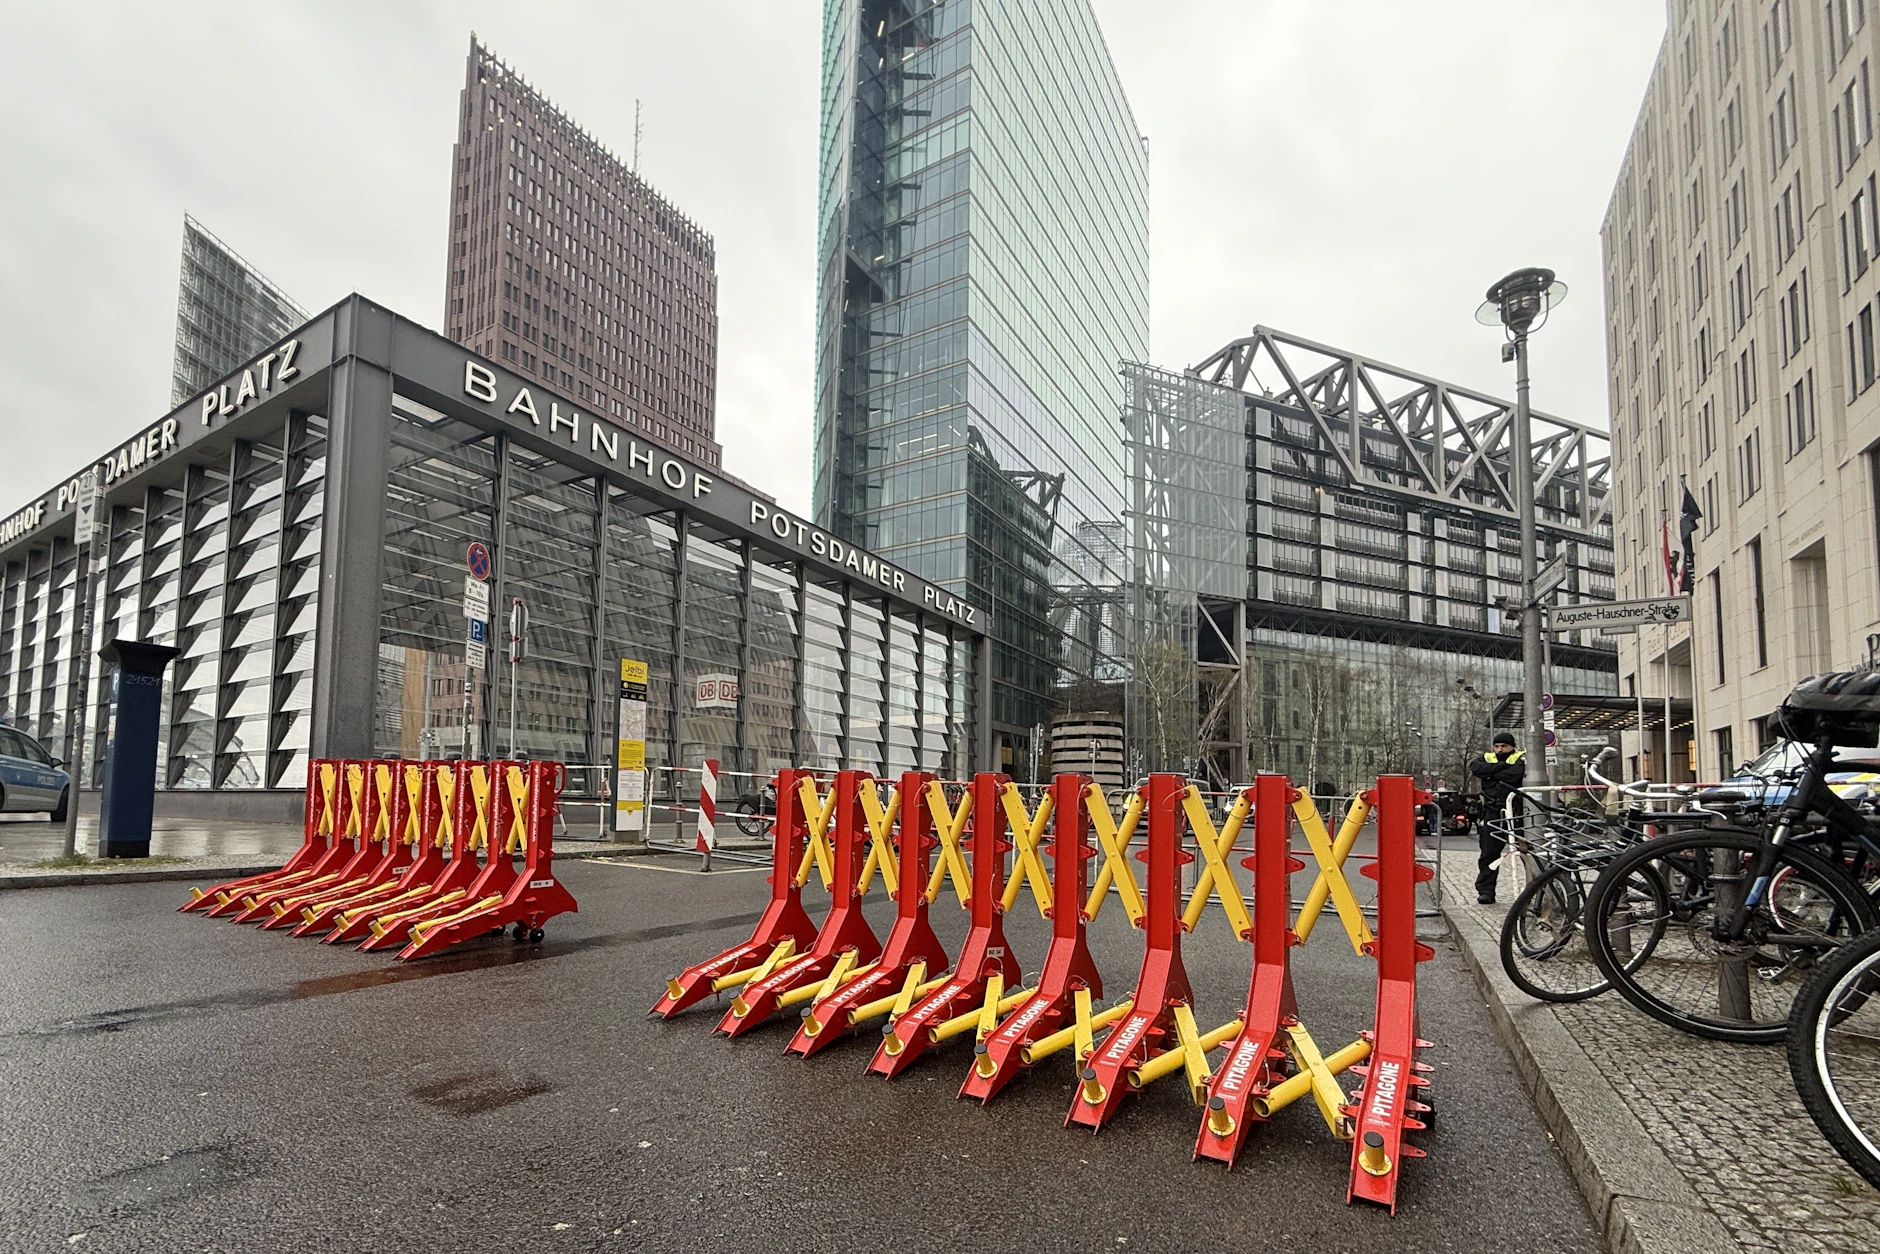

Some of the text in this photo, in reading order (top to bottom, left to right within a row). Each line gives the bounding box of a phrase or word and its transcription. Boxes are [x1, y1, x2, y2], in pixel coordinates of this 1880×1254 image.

[57, 418, 178, 511] PODAMER
[202, 340, 299, 425] PLATZ
[464, 360, 712, 498] BAHNHOF
[751, 501, 976, 624] POTSDAMER PLATZ
[472, 621, 481, 638] P
[625, 665, 644, 675] Jelbi
[700, 683, 714, 698] DB
[762, 957, 817, 988] PITAGONE
[834, 971, 886, 1003] PITAGONE
[912, 984, 961, 1019] PITAGONE
[1003, 999, 1050, 1038] PITAGONE
[1106, 1016, 1148, 1059] PITAGONE
[1222, 1040, 1260, 1091] PITAGONE
[1371, 1061, 1399, 1117] PITAGONE
